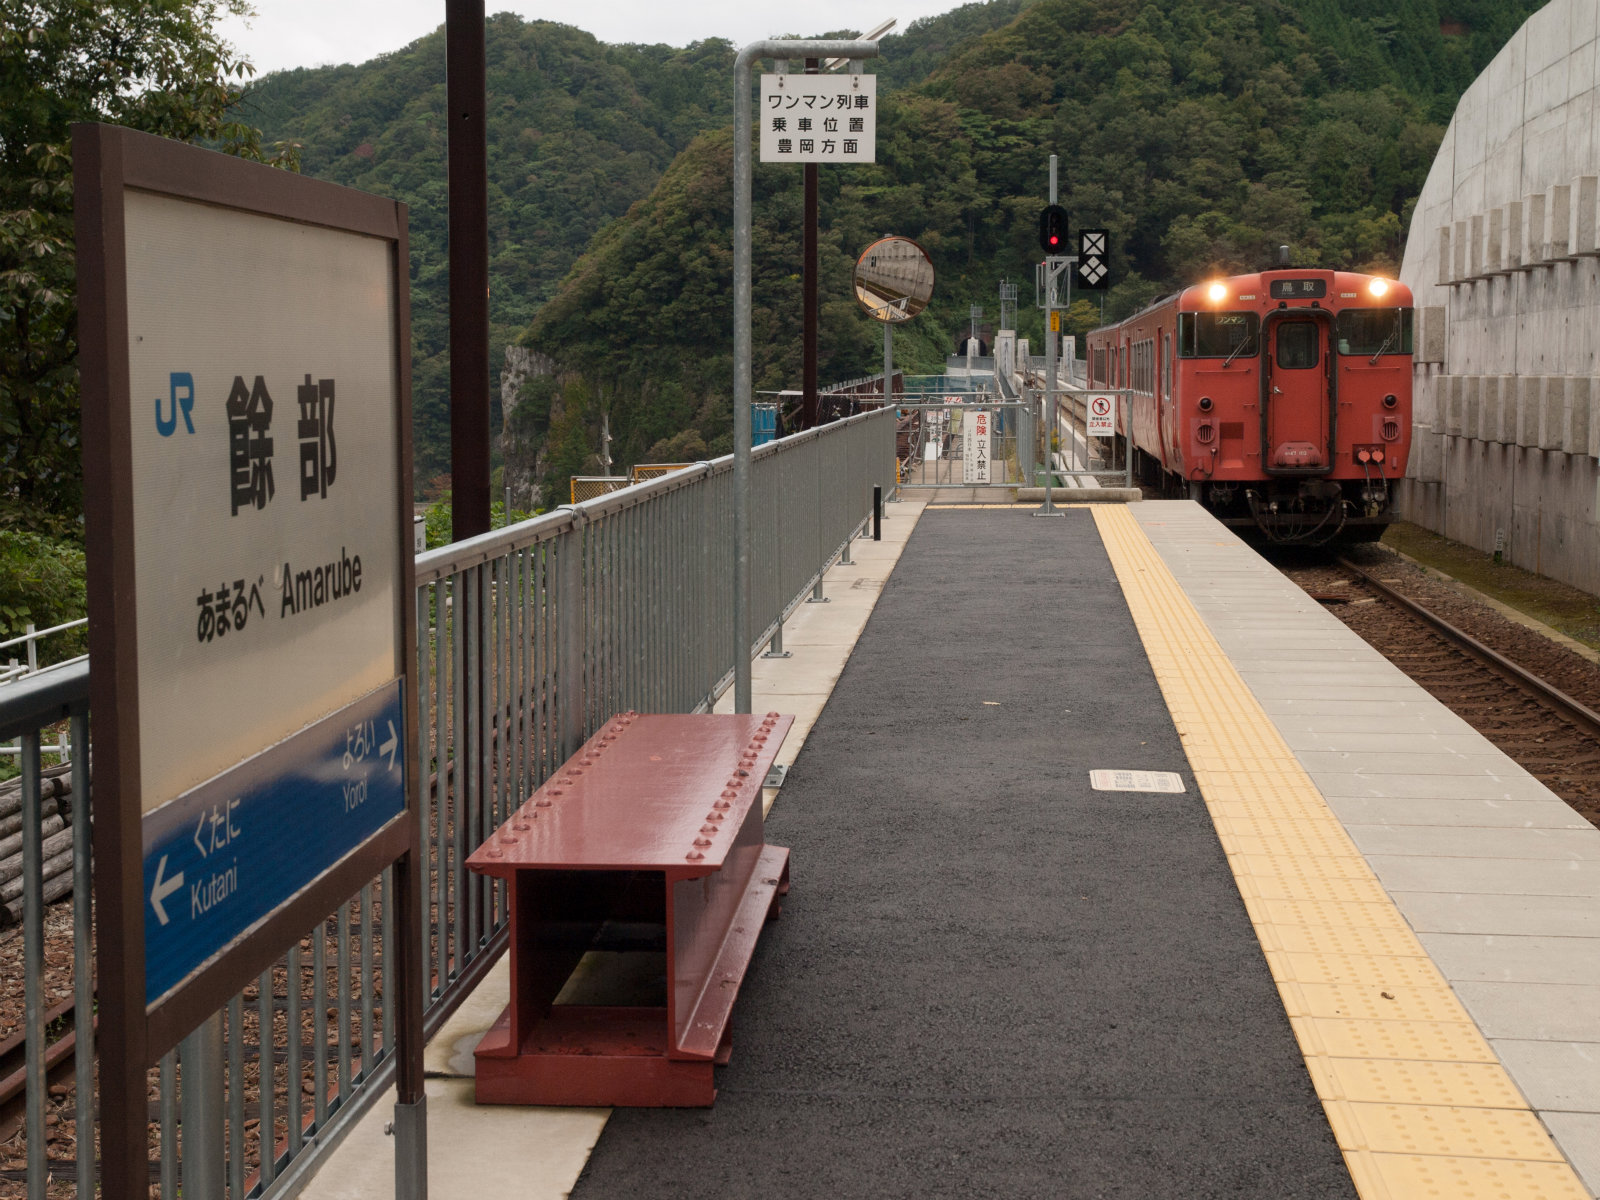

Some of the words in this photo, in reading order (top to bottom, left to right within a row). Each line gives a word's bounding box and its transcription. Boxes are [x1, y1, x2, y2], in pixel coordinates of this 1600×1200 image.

[768, 94, 869, 110] ワンマン列車
[772, 117, 864, 132] 乗車位置
[777, 138, 859, 154] 豊岡方面
[1282, 281, 1315, 292] 鳥取
[155, 371, 196, 438] JR
[976, 414, 987, 436] 危険
[225, 373, 337, 517] 餘部
[976, 439, 987, 480] 立入禁止
[196, 574, 266, 643] あまるべ
[281, 546, 362, 619] Amarube
[342, 720, 376, 771] よろい
[342, 772, 369, 813] Yoroi
[193, 798, 241, 859] くたに
[191, 856, 238, 920] Kutani
